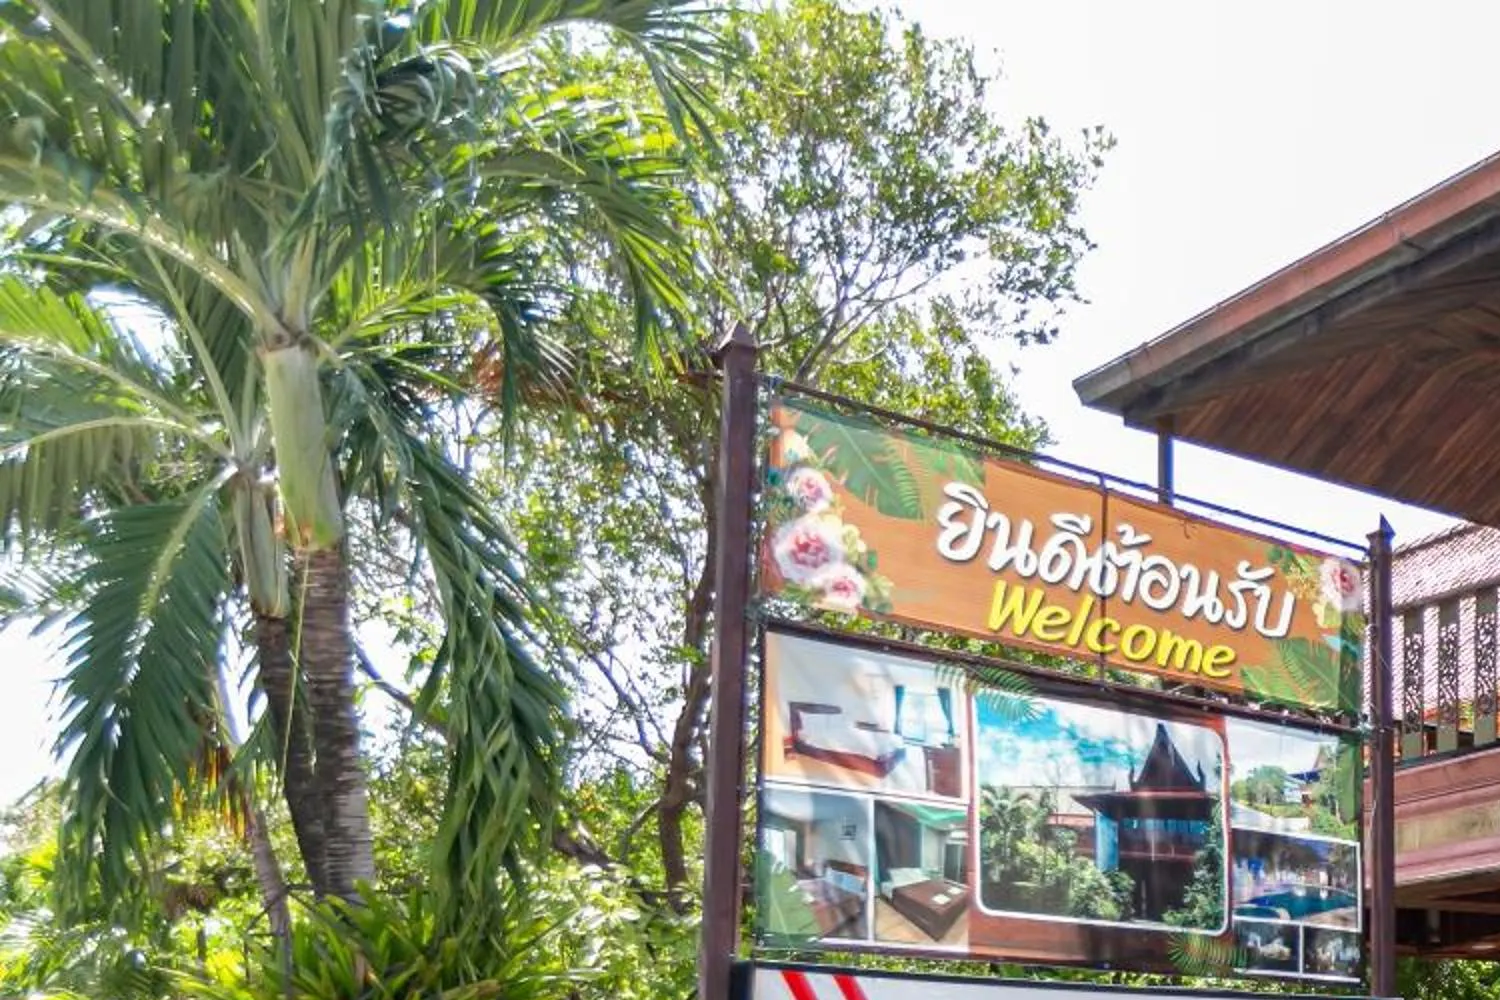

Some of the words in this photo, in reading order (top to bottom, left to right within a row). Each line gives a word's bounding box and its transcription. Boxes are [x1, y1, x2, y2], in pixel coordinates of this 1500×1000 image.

[937, 482, 1295, 638] ยินดีต้อนรับ
[987, 580, 1237, 677] Welcome
